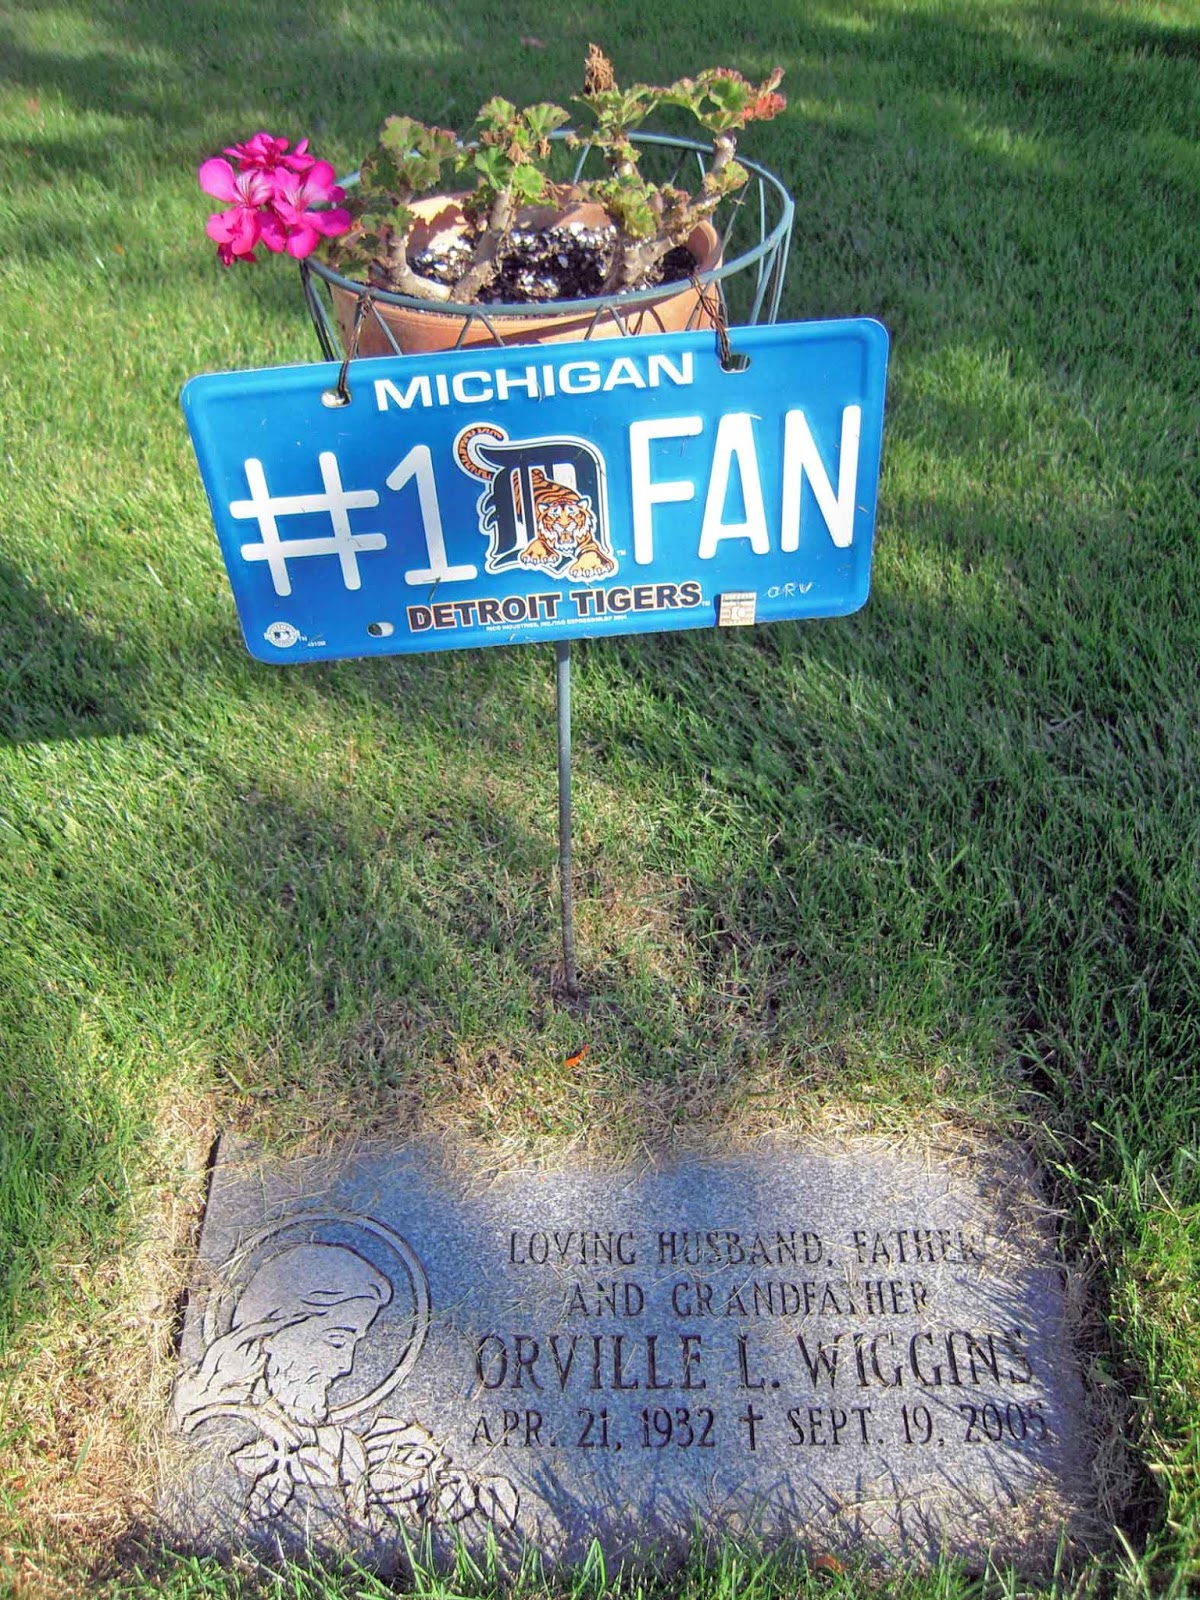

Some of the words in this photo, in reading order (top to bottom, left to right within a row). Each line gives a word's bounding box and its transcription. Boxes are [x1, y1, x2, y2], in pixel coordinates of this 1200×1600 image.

[374, 352, 694, 412] MICHIGAN
[230, 444, 478, 597] #1
[629, 404, 862, 565] FAN
[406, 593, 563, 632] DETROIT
[570, 580, 704, 618] TIGERS
[508, 1232, 637, 1265] LOVING
[657, 1230, 833, 1268] HUSBAND,
[854, 1229, 982, 1263] FATHER
[568, 1282, 644, 1316] AND
[475, 1333, 706, 1391] ORVILLE
[737, 1332, 781, 1390] L.
[796, 1328, 1034, 1388] WIGGINS
[471, 1410, 557, 1447] APR.
[576, 1407, 622, 1451] 21,
[642, 1406, 716, 1448] 1932
[787, 1405, 884, 1447] SEPT.
[901, 1404, 945, 1447] 19,
[959, 1401, 1047, 1443] 2005
